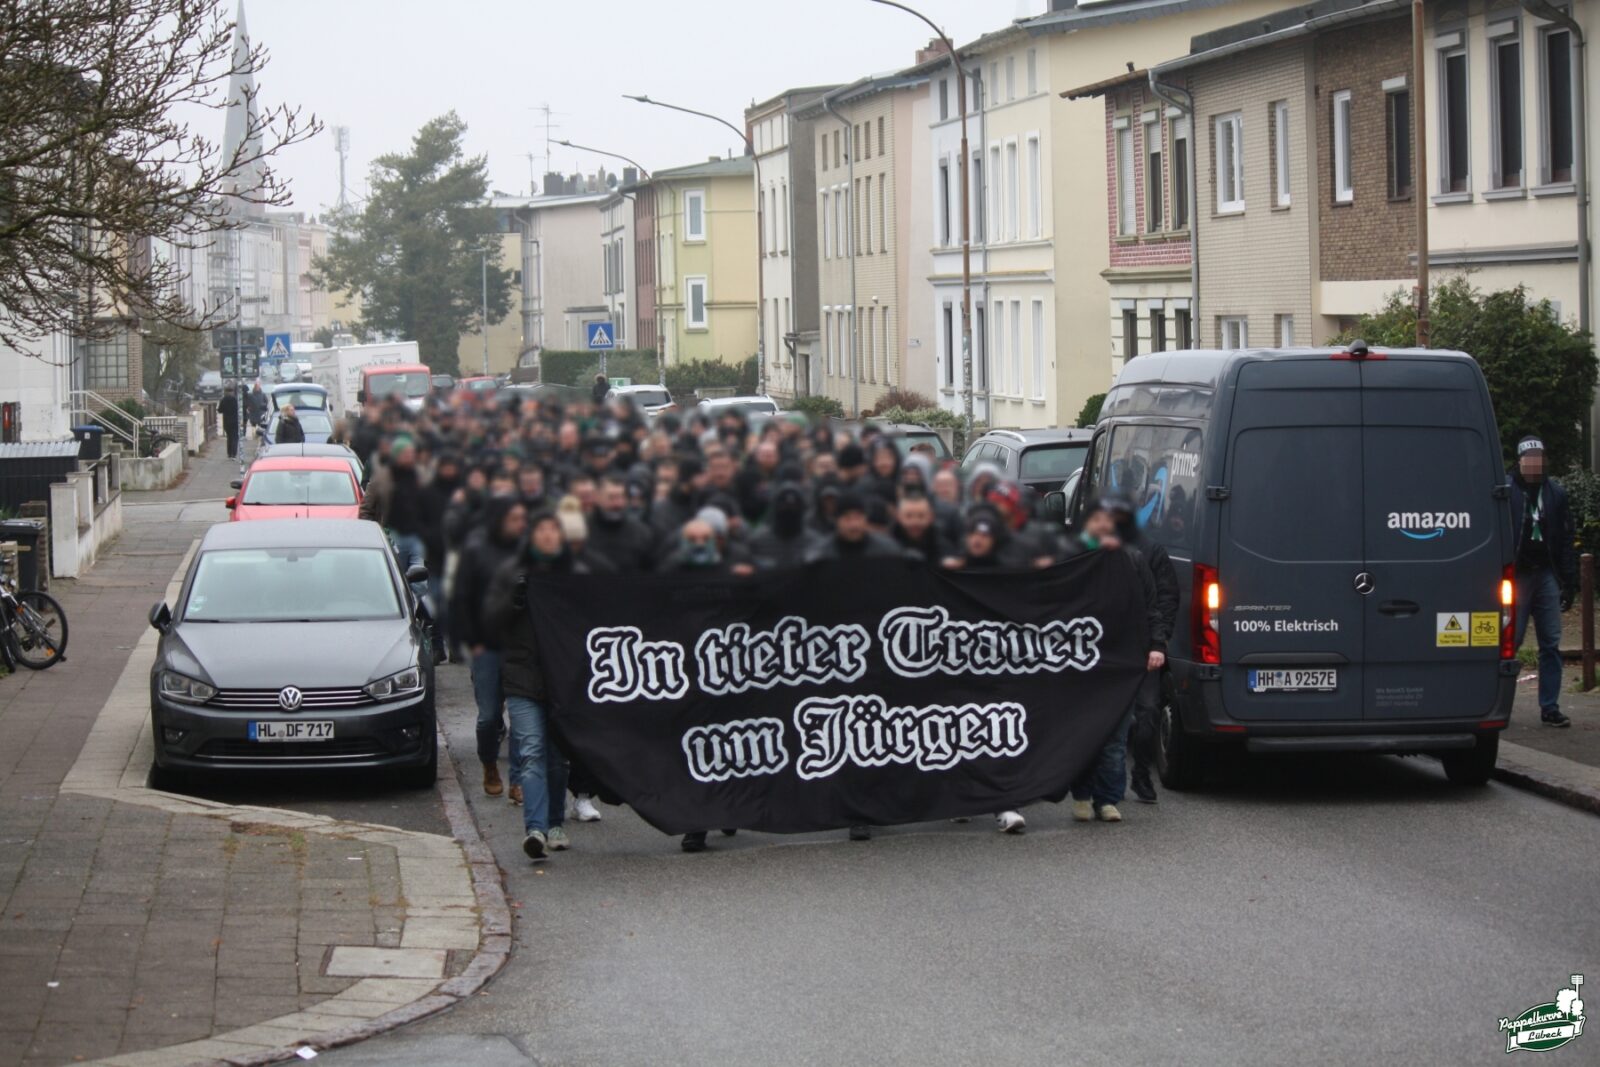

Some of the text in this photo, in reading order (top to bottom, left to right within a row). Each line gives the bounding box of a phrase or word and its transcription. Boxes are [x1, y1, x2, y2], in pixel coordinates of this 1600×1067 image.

[1170, 443, 1199, 484] prime
[1387, 511, 1471, 529] amazon
[1233, 619, 1339, 632] 100% Elektrisch
[587, 605, 1104, 703] In tiefer Trauer
[1257, 671, 1274, 686] HH
[258, 723, 276, 737] HL
[681, 694, 1028, 782] um Jürgen
